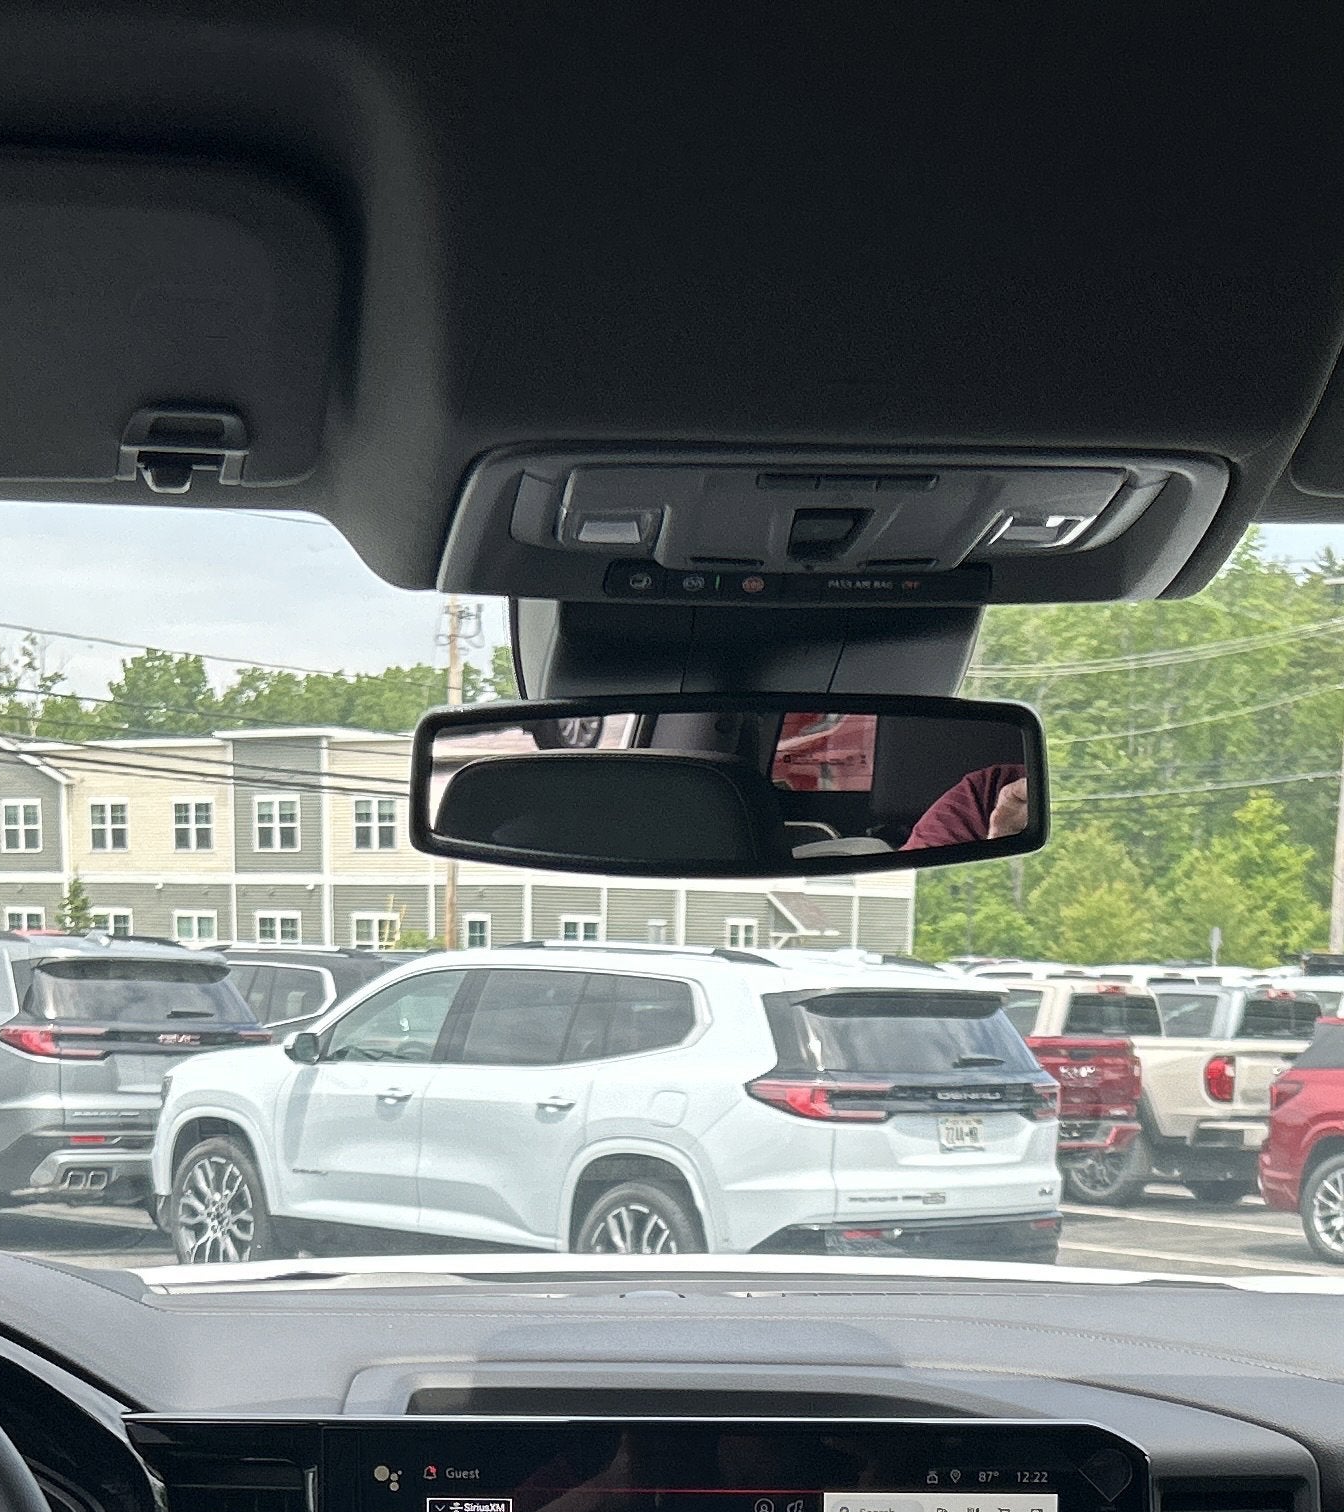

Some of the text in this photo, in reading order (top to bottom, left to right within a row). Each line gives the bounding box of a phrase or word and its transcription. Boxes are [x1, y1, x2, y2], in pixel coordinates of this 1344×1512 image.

[446, 1468, 480, 1480] Guest
[978, 1471, 1000, 1482] 87°
[1017, 1471, 1048, 1483] 12:22
[464, 1503, 506, 1512] SiriusXM
